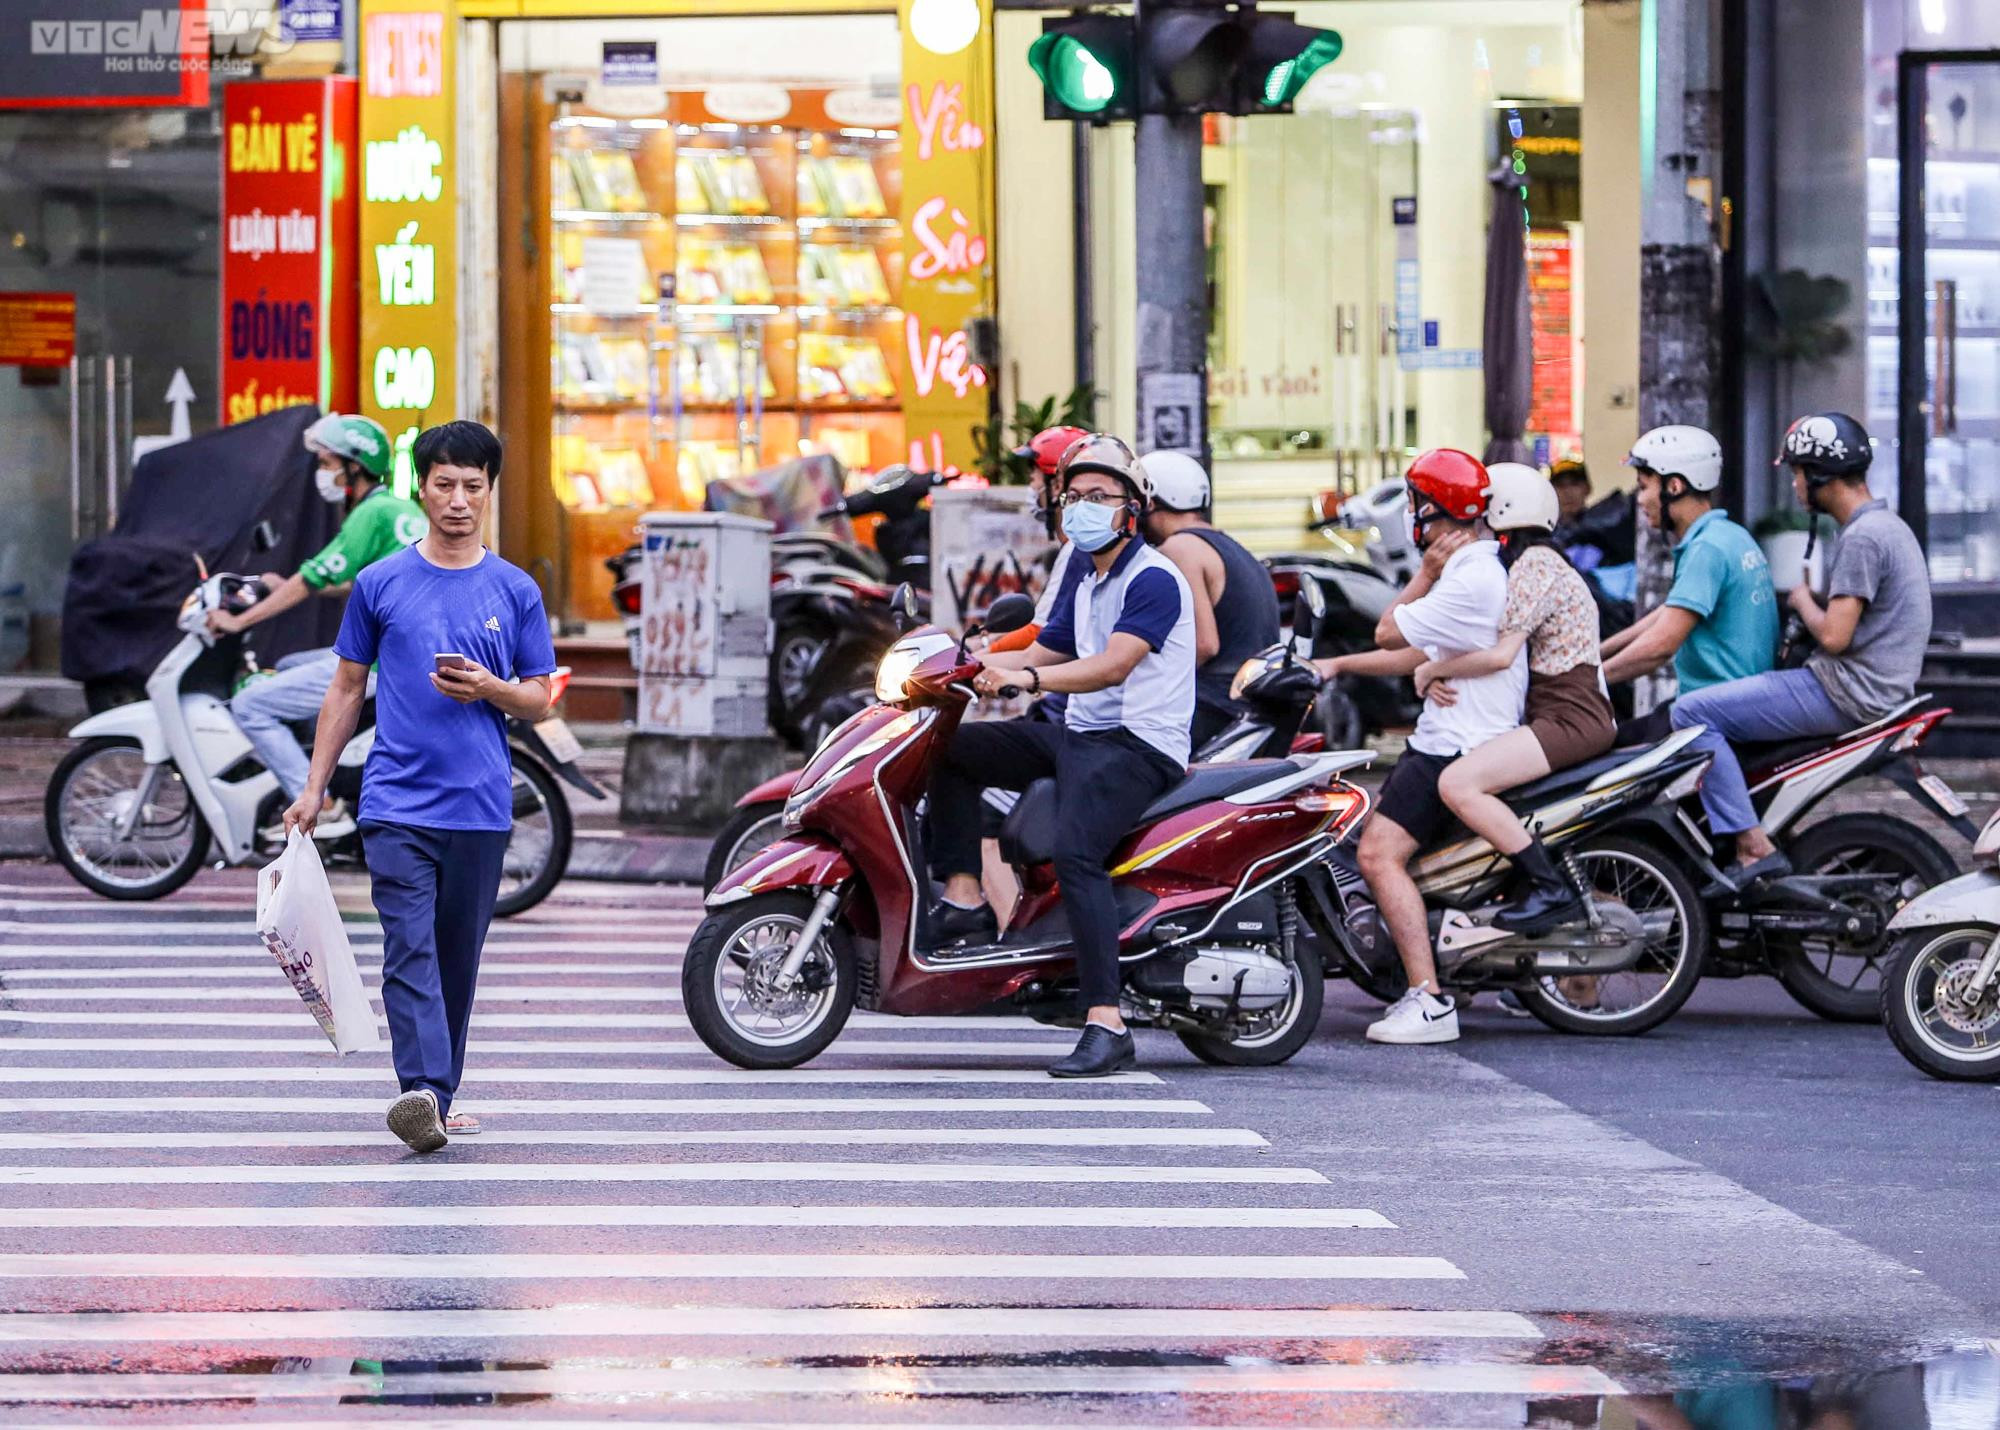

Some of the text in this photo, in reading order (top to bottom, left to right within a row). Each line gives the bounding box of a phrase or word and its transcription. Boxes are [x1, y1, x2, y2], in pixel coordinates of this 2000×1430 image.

[230, 106, 281, 172] BẢN
[375, 220, 435, 305] YẾN
[374, 345, 435, 410] CAO
